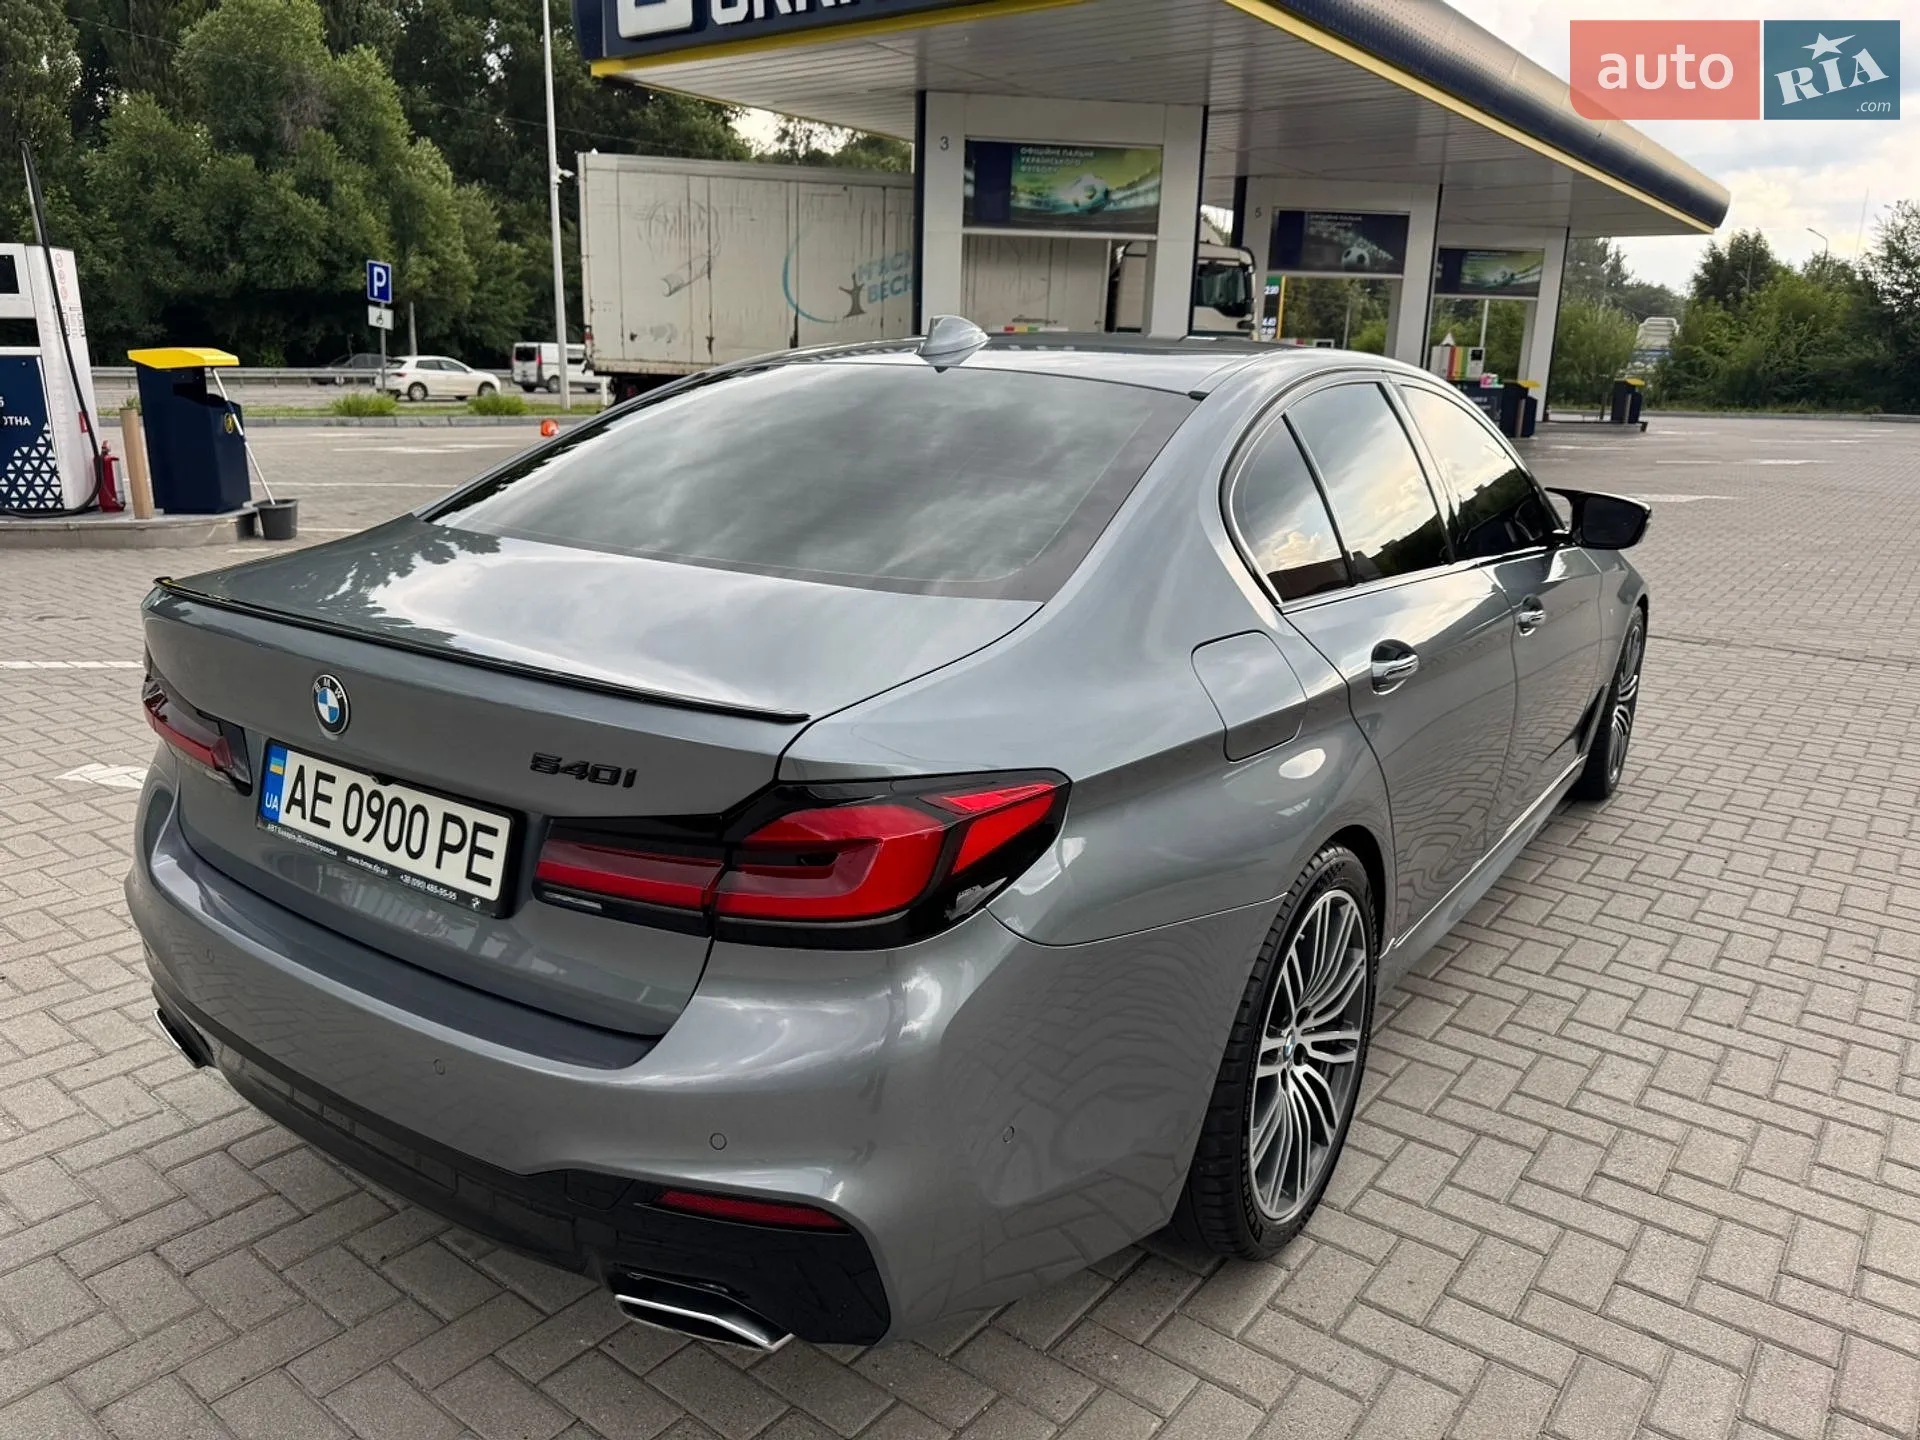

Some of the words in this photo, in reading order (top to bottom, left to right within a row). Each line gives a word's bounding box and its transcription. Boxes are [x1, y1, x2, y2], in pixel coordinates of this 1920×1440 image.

[939, 136, 950, 151] 3
[373, 266, 387, 297] P
[265, 792, 279, 812] UA
[285, 764, 337, 829] AE
[342, 782, 430, 860] 0900
[435, 811, 499, 887] PE
